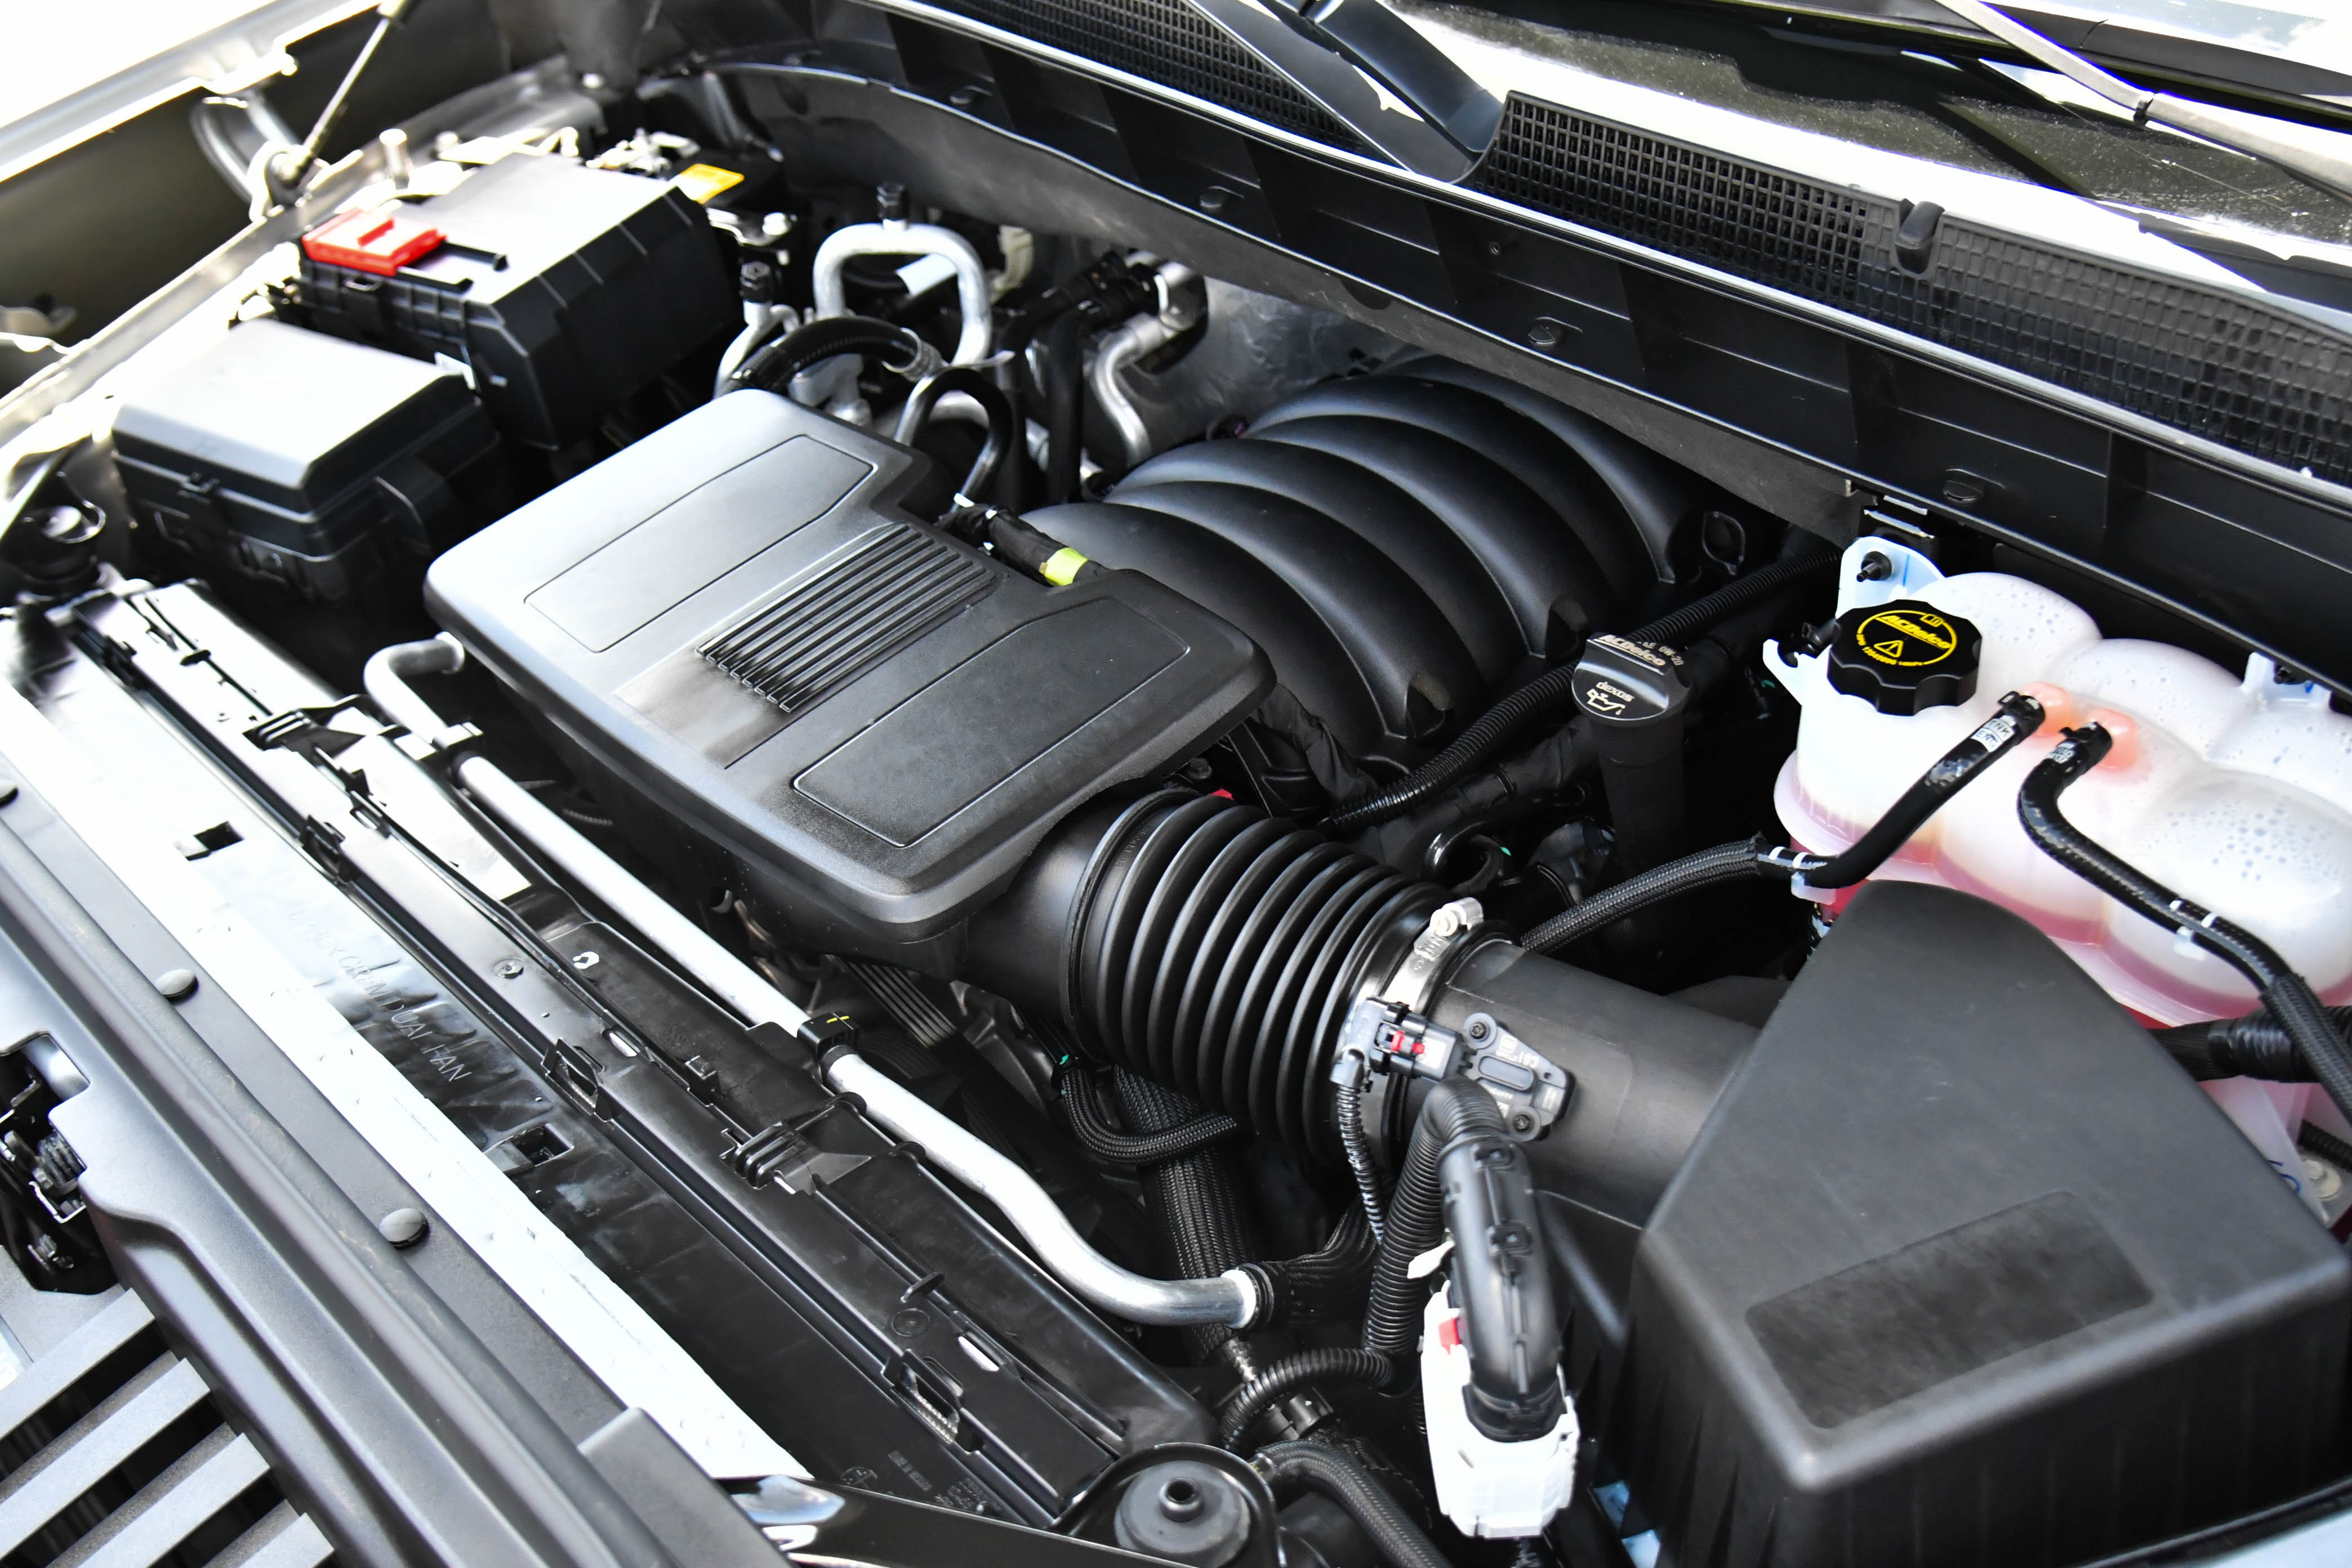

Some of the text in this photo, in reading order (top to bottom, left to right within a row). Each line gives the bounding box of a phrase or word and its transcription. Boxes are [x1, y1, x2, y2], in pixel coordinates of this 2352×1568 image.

[1878, 615, 1952, 649] ACDelco
[1598, 634, 1665, 666] ACDelco
[1659, 646, 1684, 666] 0W-20
[1596, 681, 1635, 702] dexos
[378, 997, 433, 1046] DUAL
[422, 1044, 472, 1082] FAN
